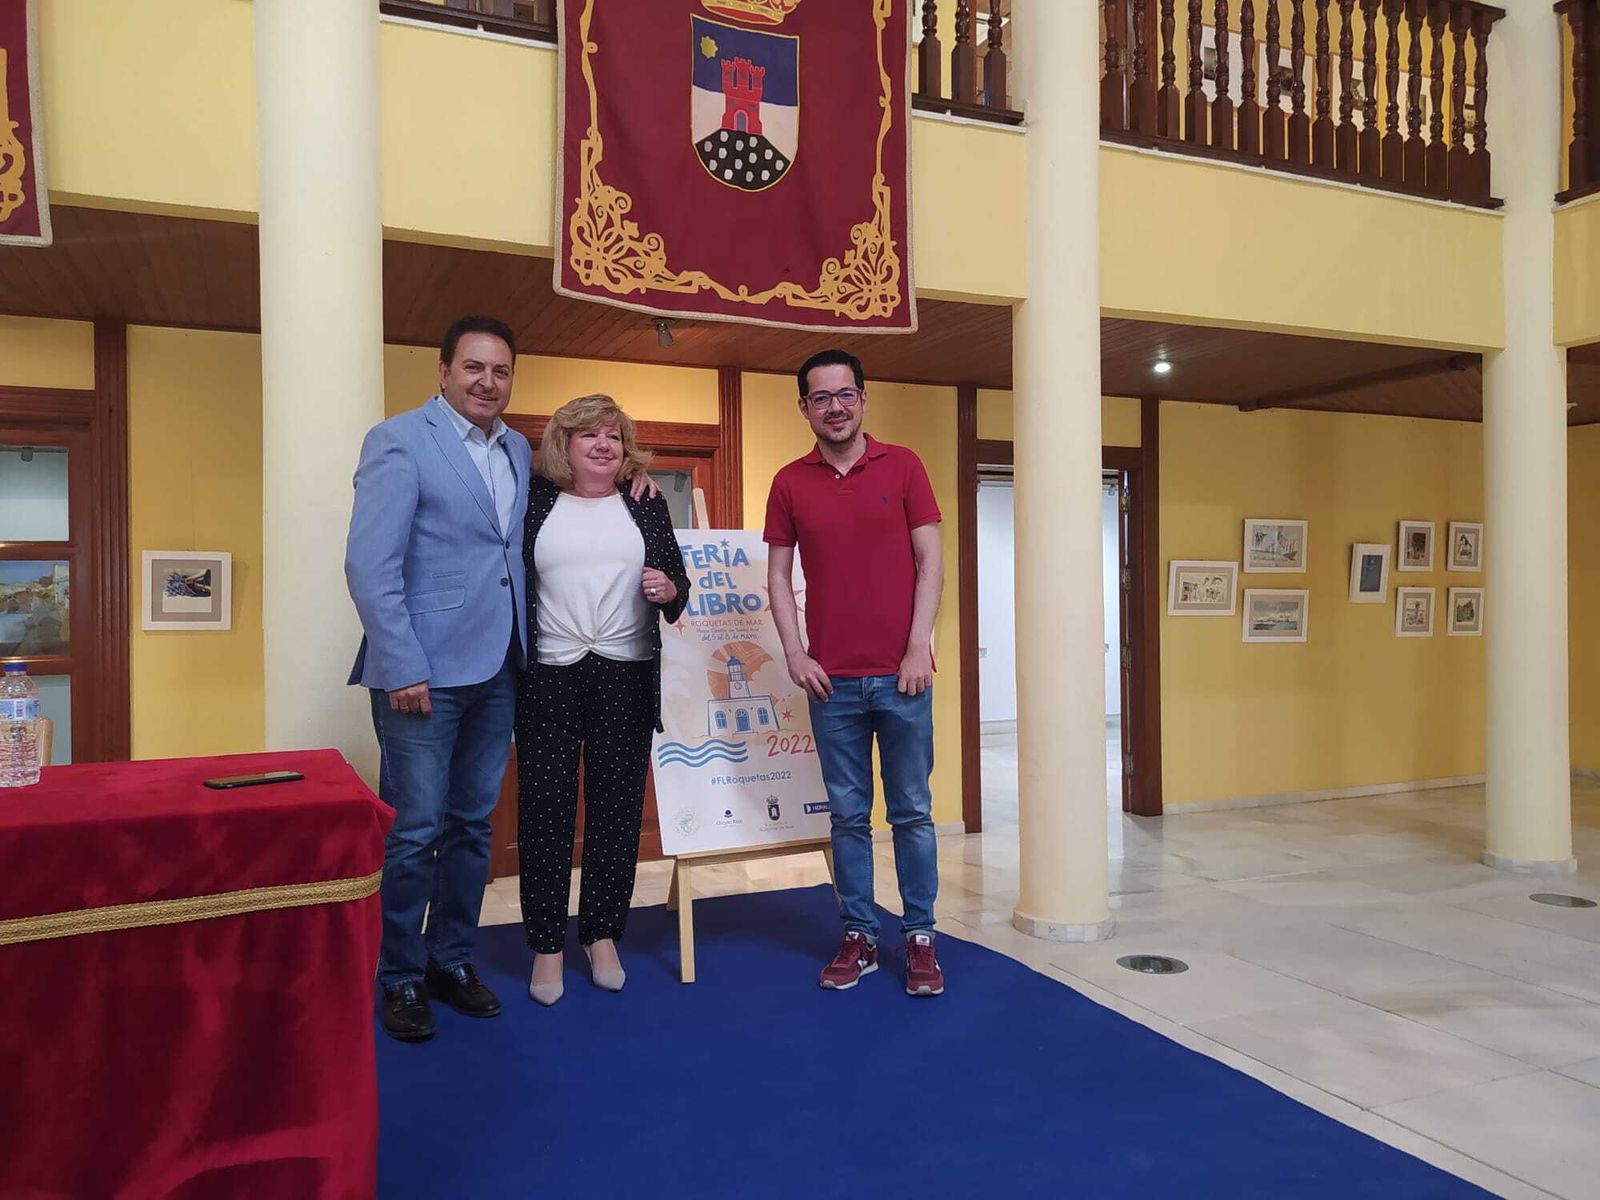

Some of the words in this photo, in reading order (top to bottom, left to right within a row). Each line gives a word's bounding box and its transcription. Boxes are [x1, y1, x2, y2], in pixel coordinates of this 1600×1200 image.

[686, 593, 762, 616] LIBRO
[767, 734, 816, 757] 2022
[711, 770, 792, 785] #FLRoquetas2022
